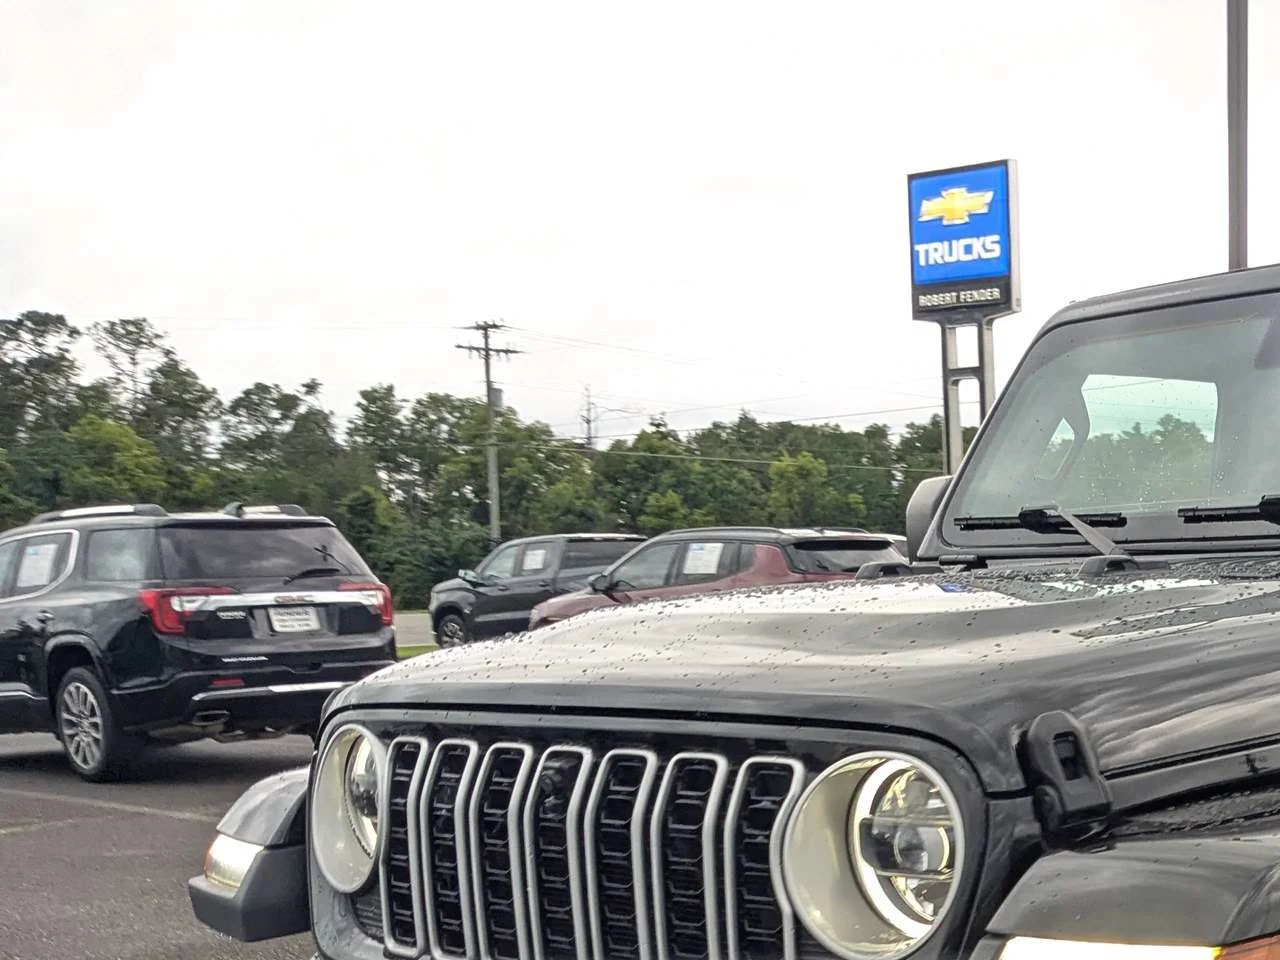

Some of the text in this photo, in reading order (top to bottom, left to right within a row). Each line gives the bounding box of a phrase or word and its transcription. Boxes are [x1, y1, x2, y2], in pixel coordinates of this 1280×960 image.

[914, 235, 1001, 266] TRUCKS
[918, 288, 1001, 306] ROBERT FENDER
